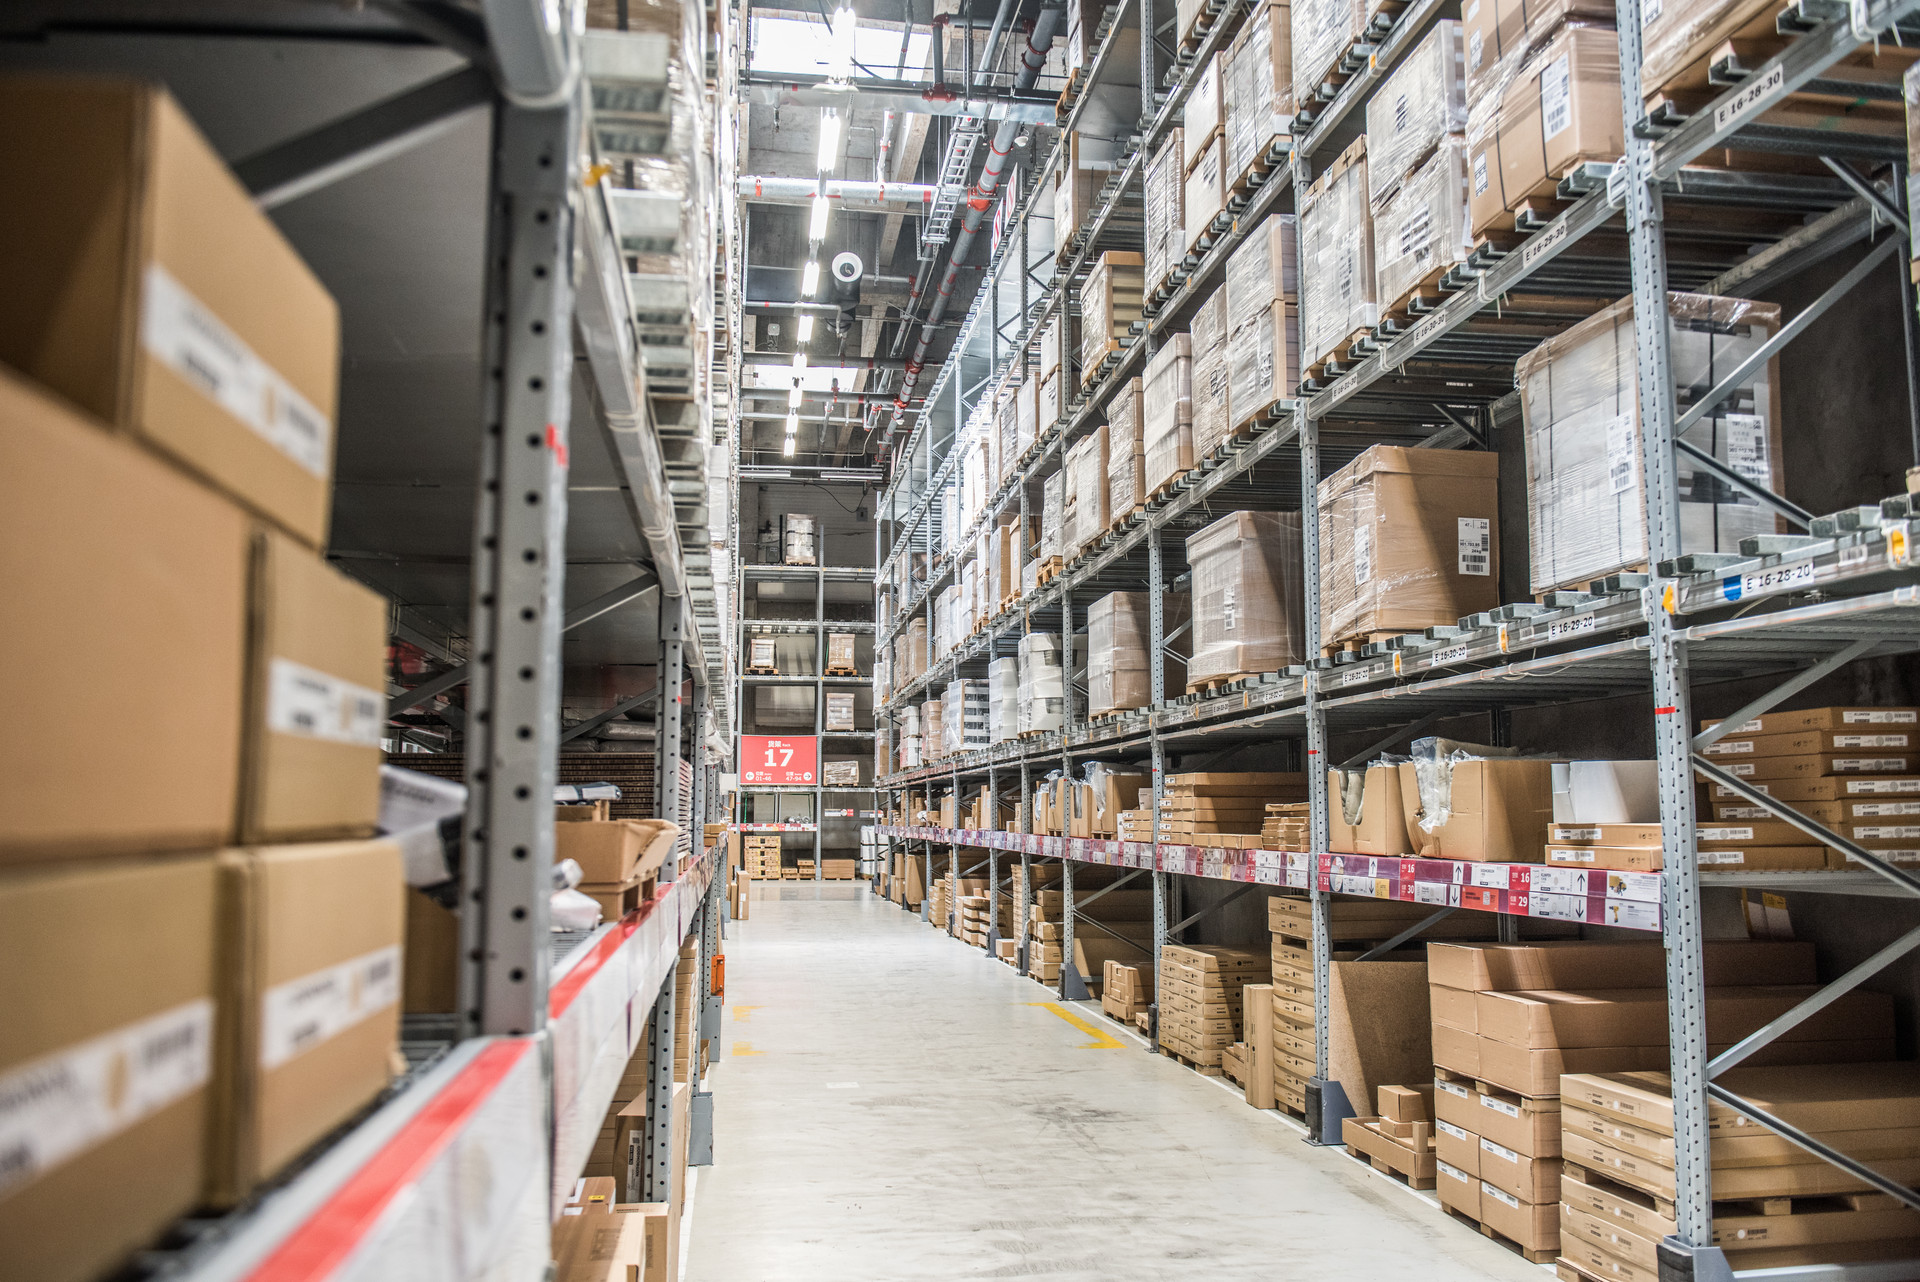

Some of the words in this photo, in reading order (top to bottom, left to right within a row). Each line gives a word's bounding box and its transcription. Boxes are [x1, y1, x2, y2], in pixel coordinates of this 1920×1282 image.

[1719, 110, 1726, 122] E
[1730, 71, 1781, 115] 16-28-30
[1533, 225, 1565, 256] 16-29-30
[1421, 313, 1445, 337] 16-30-30
[1746, 577, 1753, 590] E
[1758, 564, 1810, 588] 16-28-20
[1558, 616, 1593, 634] 16-29-20
[1440, 646, 1466, 661] 16-30-20
[764, 748, 794, 767] 17
[1407, 864, 1415, 873] 16
[1323, 877, 1329, 886] 31
[1520, 872, 1530, 883] 16
[1407, 884, 1415, 894] 30
[1518, 896, 1528, 907] 29
